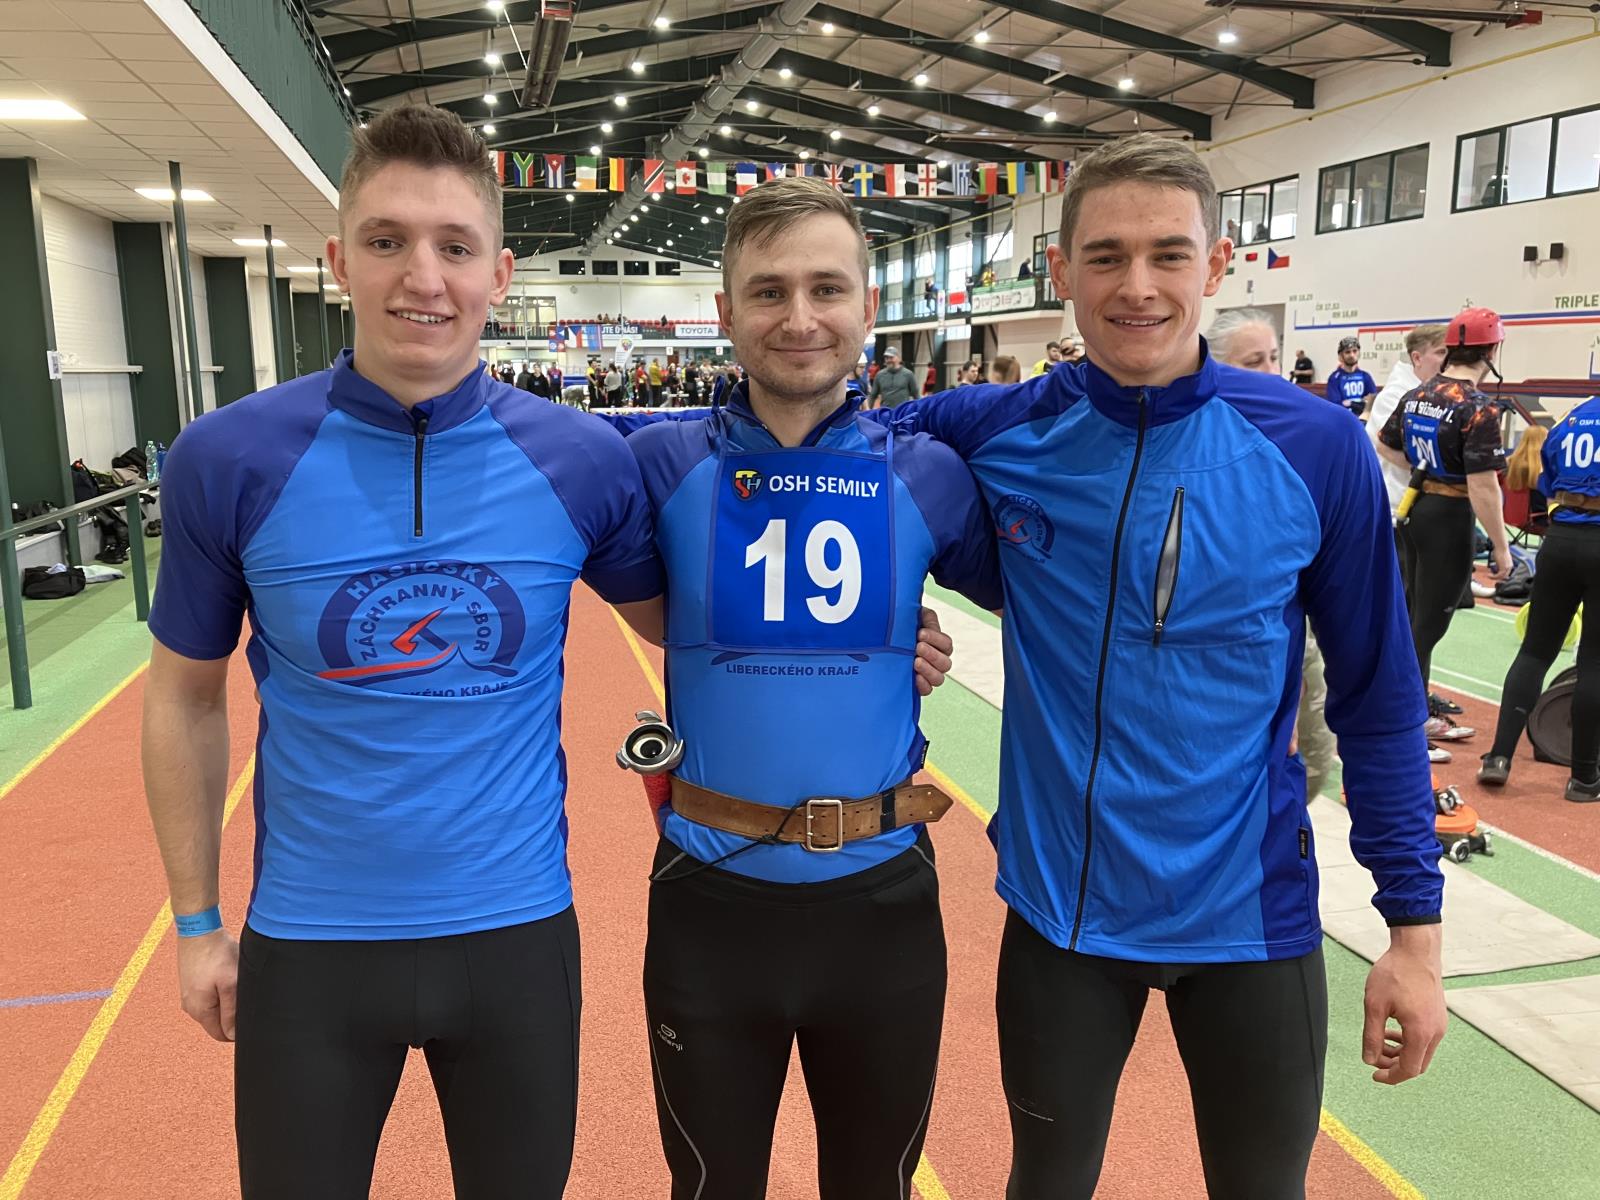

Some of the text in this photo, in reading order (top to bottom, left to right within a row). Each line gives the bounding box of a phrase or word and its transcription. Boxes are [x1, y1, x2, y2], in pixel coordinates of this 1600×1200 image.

[1555, 294, 1599, 309] TRIPLE
[680, 327, 714, 335] TOYOTA
[1344, 381, 1364, 397] 100
[1578, 419, 1594, 427] OSH
[769, 475, 880, 498] OSH SEMILY
[745, 519, 862, 624] 19
[466, 601, 492, 652] SBOR
[726, 664, 860, 676] LIBERECKÉHO KRAJE
